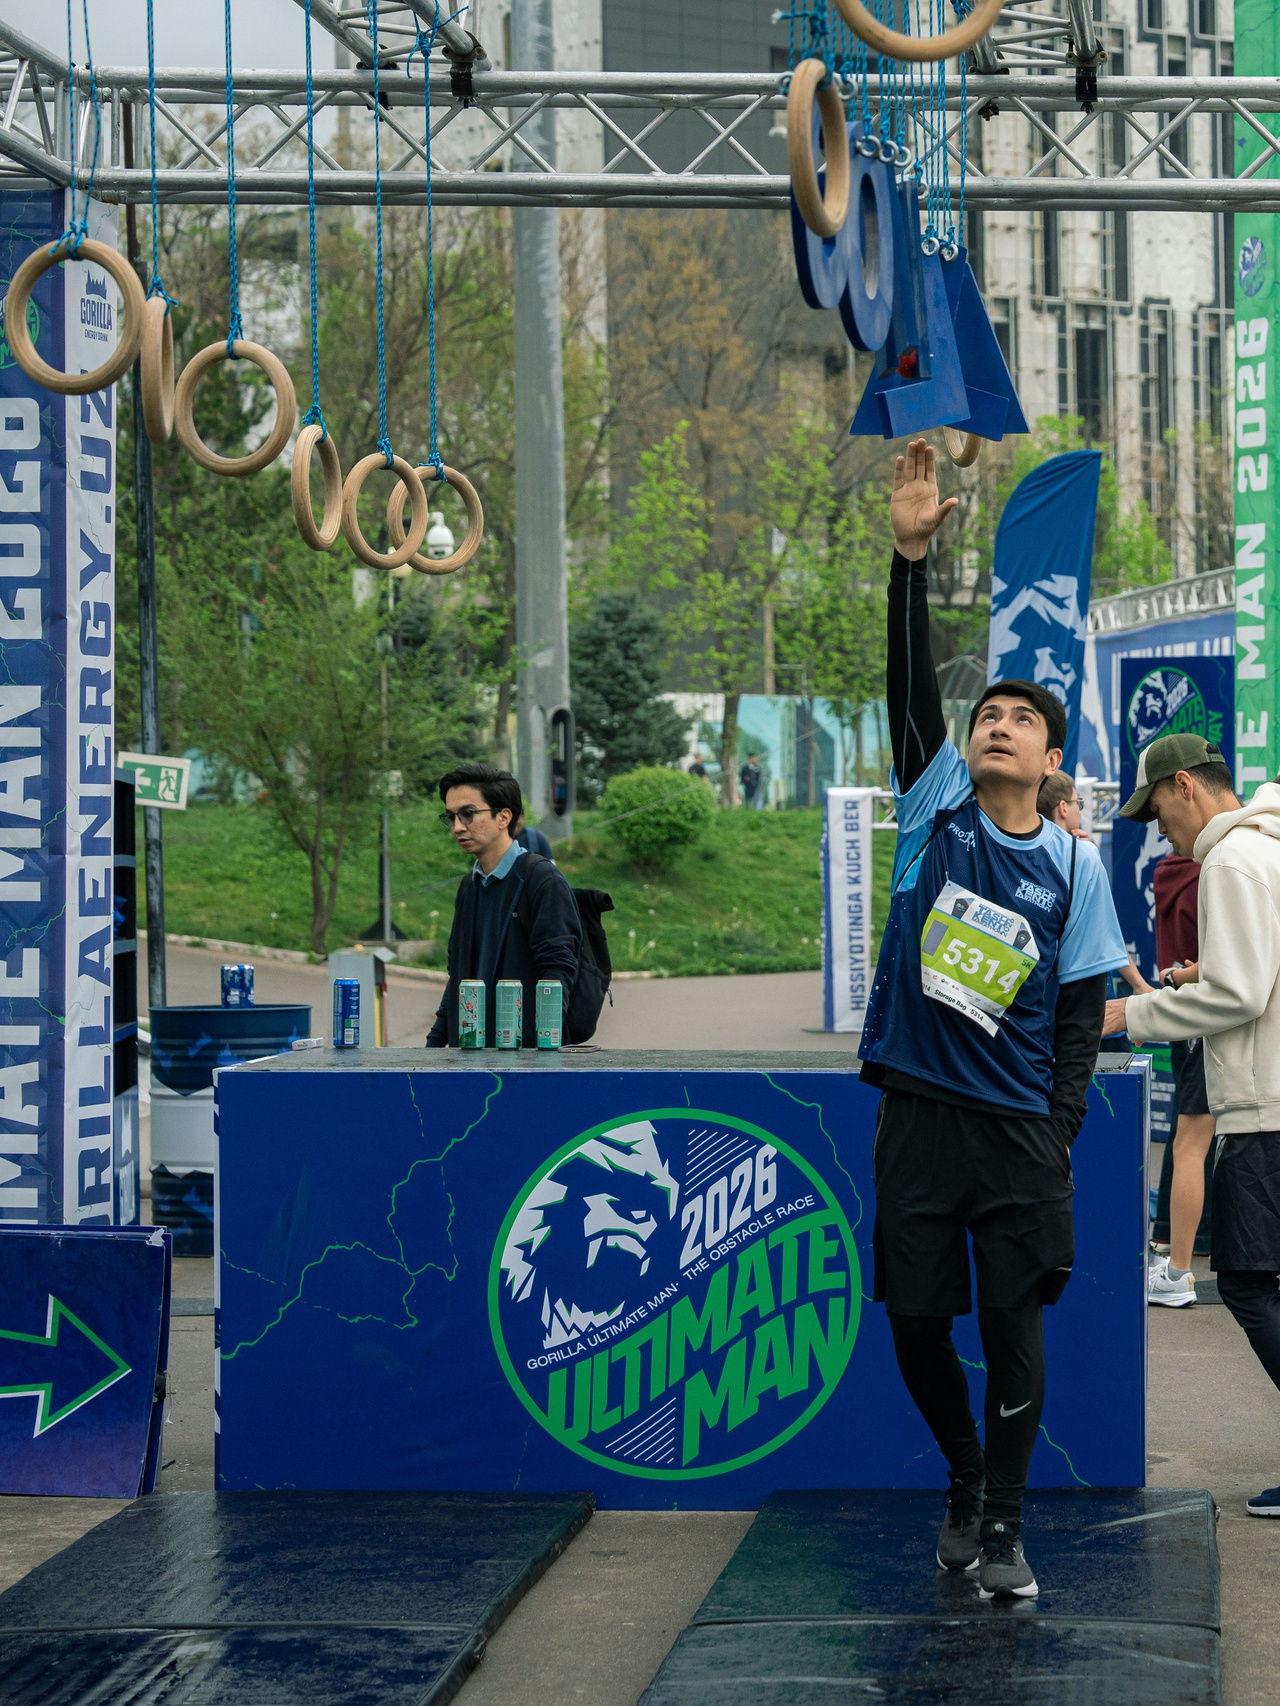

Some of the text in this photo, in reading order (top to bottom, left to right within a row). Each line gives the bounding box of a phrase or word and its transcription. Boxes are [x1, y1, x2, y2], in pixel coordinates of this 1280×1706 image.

[80, 297, 113, 331] GORILLA
[84, 329, 109, 343] ENERGY DRINK
[1236, 317, 1269, 494] 2026
[1236, 523, 1266, 680] MAN
[844, 799, 866, 1012] HISSIYOTINGA KUCH BER
[942, 938, 1021, 994] 5314
[1021, 959, 1033, 970] 5K
[934, 989, 956, 1003] Storage
[956, 1000, 967, 1011] Bag
[970, 1009, 984, 1021] 5314
[679, 1143, 778, 1270] 2026
[526, 1336, 588, 1371] GORILLA
[587, 1308, 649, 1348] ULTIMATE
[682, 1258, 710, 1281] THE
[709, 1212, 776, 1262] OBSTACLE
[775, 1194, 815, 1218] RACE
[548, 1220, 847, 1442] ULTIMATE
[682, 1296, 845, 1467] MAN
